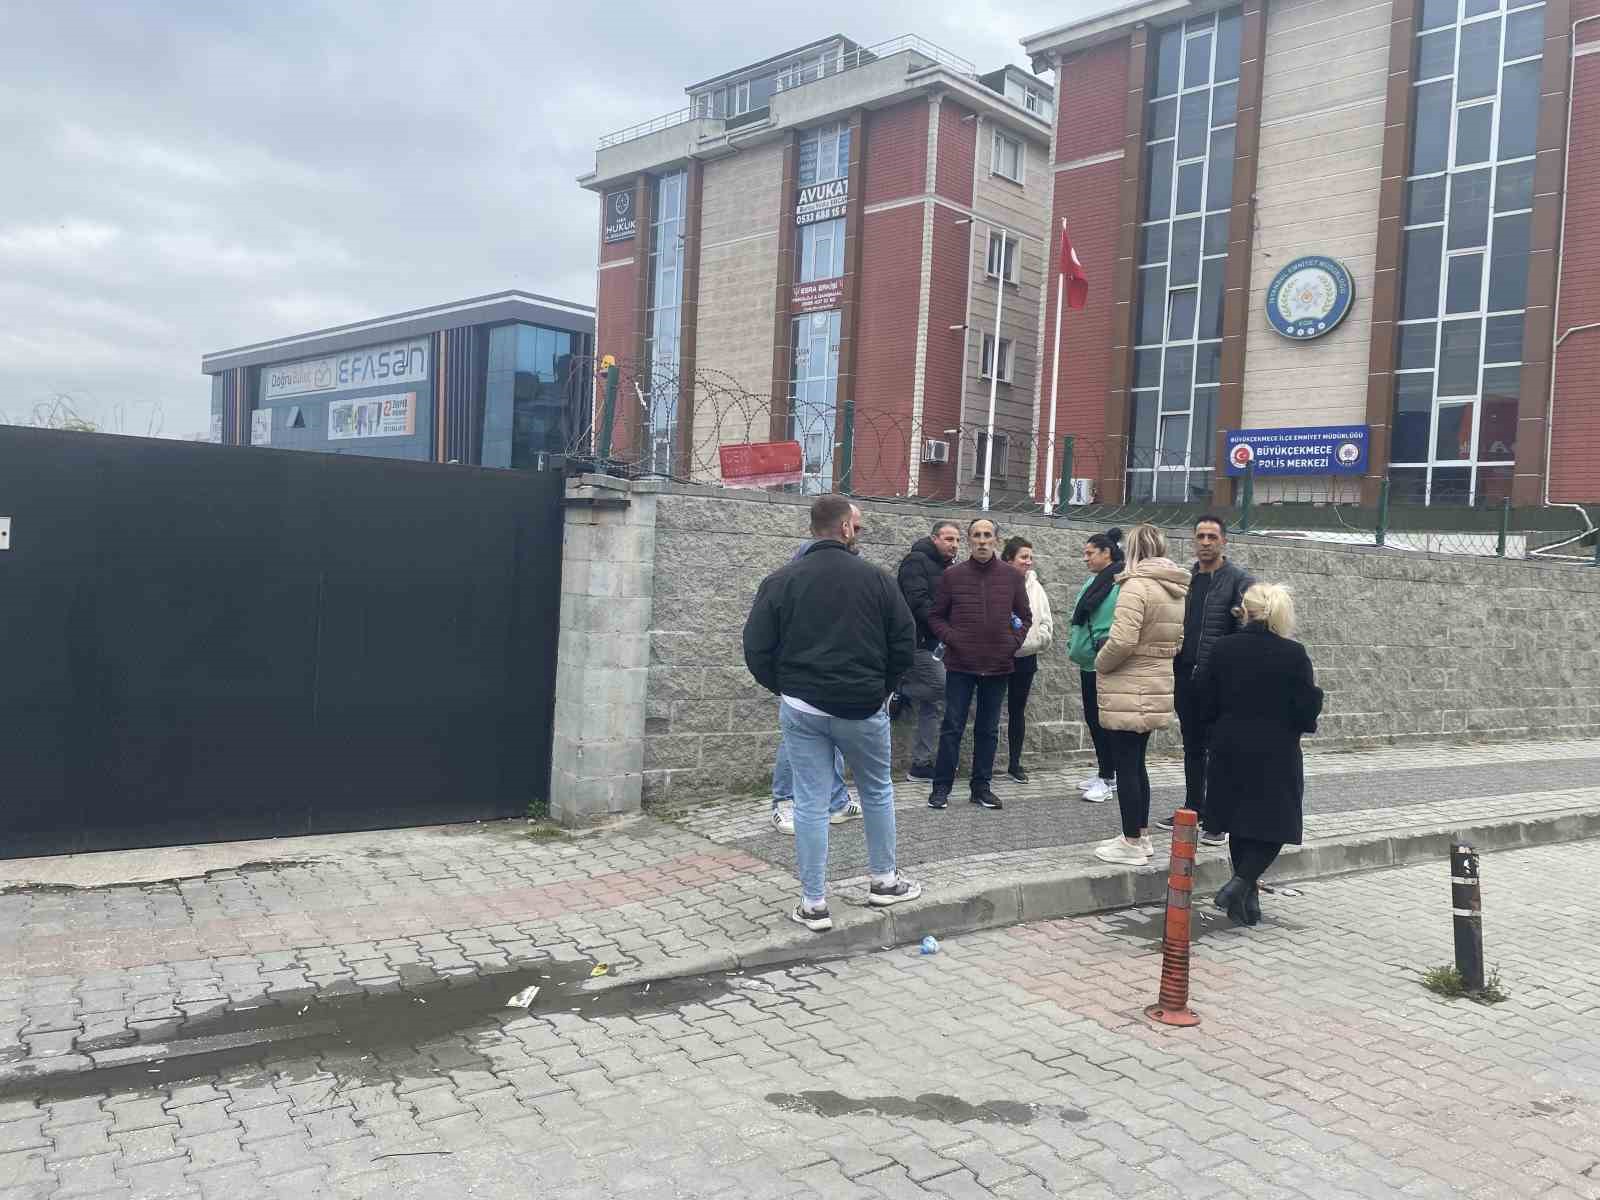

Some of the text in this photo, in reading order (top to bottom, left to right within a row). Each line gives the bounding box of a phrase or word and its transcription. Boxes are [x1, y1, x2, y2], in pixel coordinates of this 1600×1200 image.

[799, 180, 848, 205] AVUKAT
[606, 220, 637, 233] HUKUK
[1293, 433, 1321, 441] EMNİYET
[1256, 444, 1333, 457] BÜYÜKÇEKMECE
[1258, 456, 1329, 468] POLİS MERKEZİ
